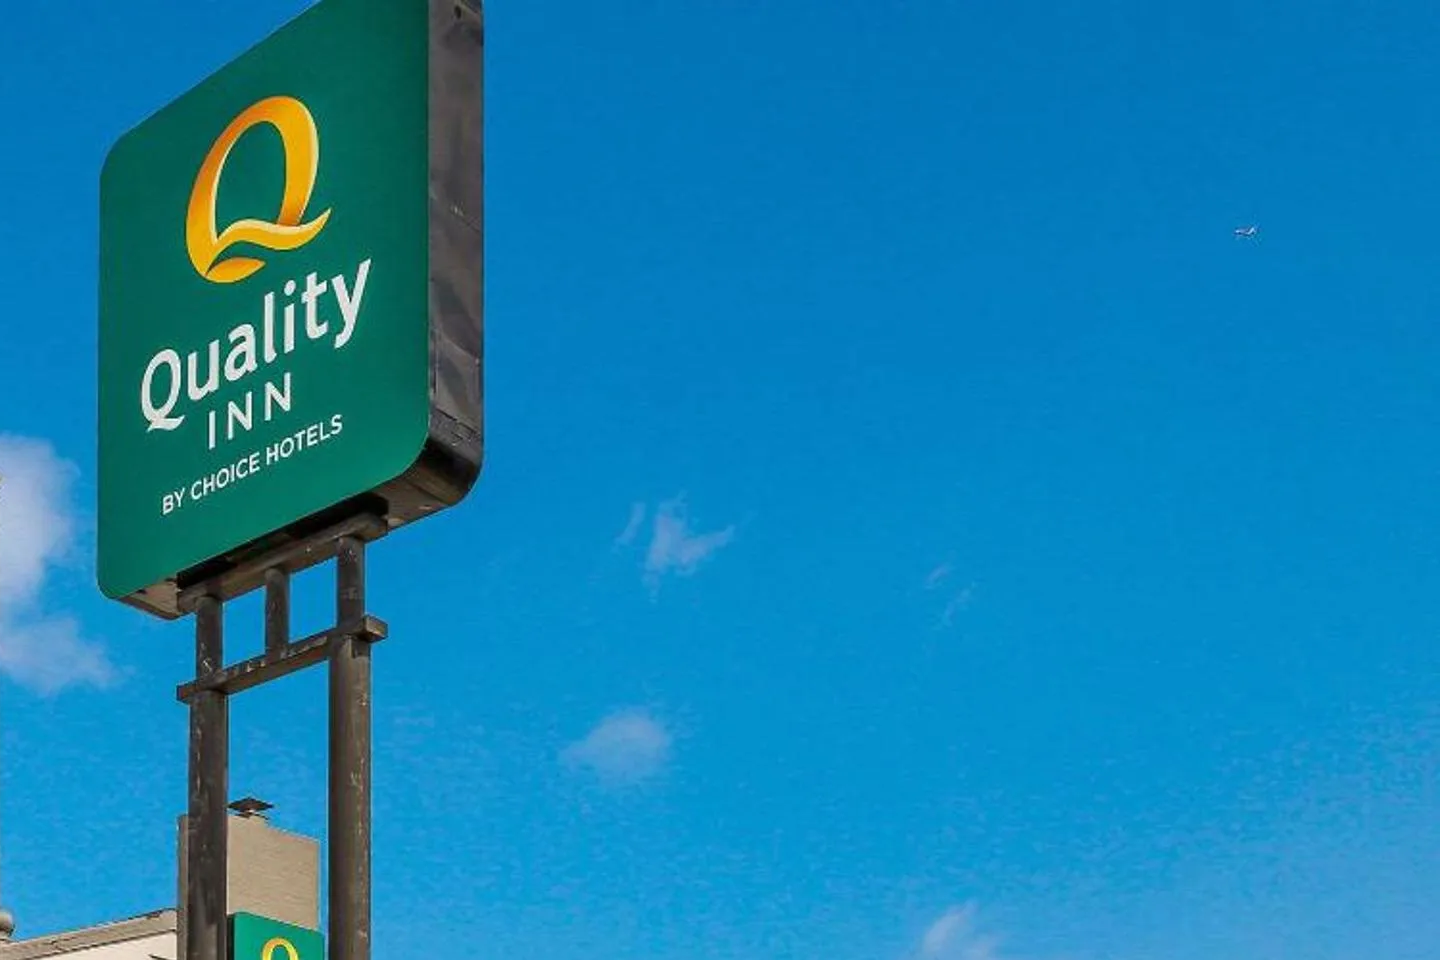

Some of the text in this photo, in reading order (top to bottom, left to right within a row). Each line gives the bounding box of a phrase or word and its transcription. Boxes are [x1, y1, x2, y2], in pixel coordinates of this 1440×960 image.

[140, 258, 372, 432] Quality
[207, 372, 293, 450] INN
[162, 414, 343, 516] BY CHOICE HOTELS
